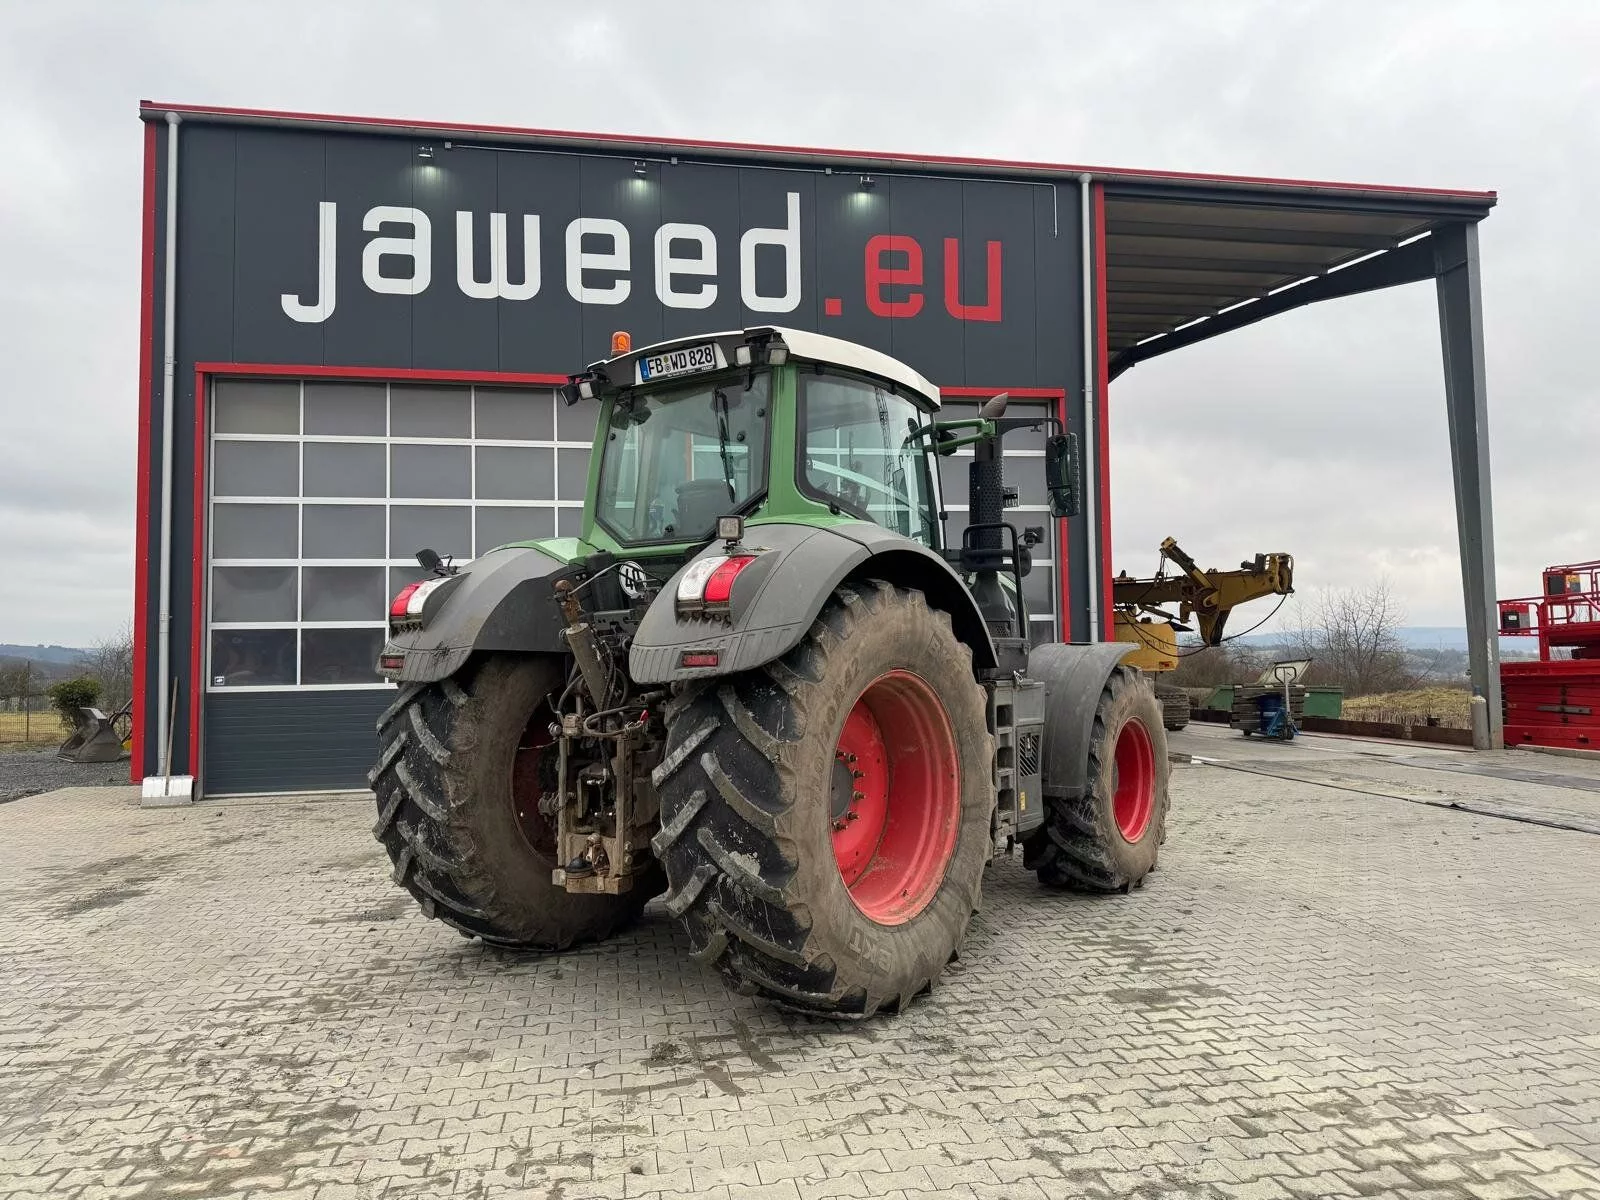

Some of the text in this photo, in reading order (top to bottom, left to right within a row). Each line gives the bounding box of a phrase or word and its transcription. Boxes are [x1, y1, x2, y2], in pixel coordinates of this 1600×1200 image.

[648, 358, 664, 375] FB
[670, 352, 687, 371] WD
[690, 347, 713, 367] 828
